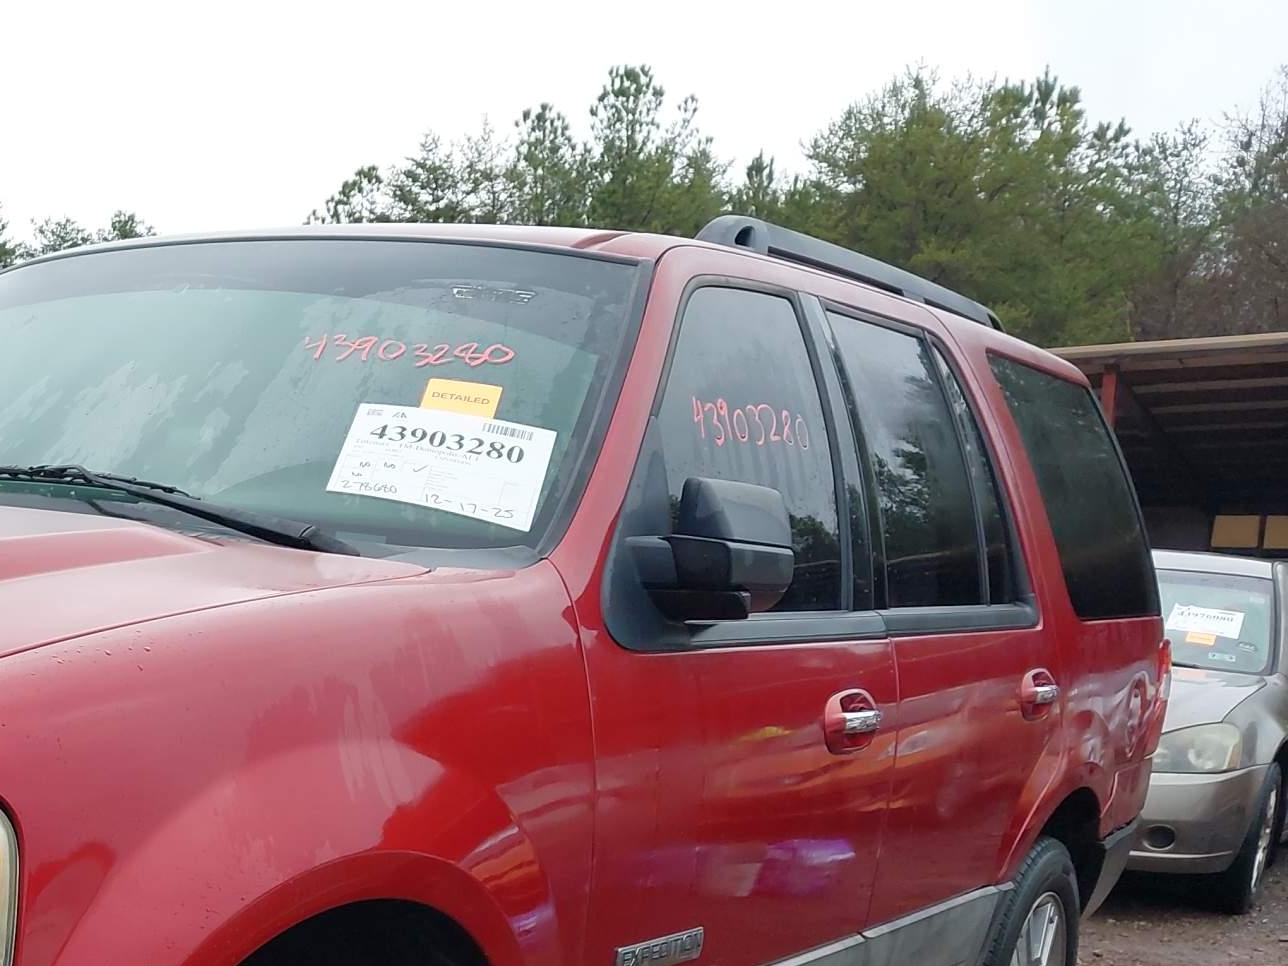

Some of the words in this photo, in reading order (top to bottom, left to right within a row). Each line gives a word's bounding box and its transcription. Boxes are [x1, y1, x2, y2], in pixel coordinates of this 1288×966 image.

[431, 390, 491, 406] DETAILED
[692, 395, 809, 450] 43903280
[369, 423, 525, 464] 43903280
